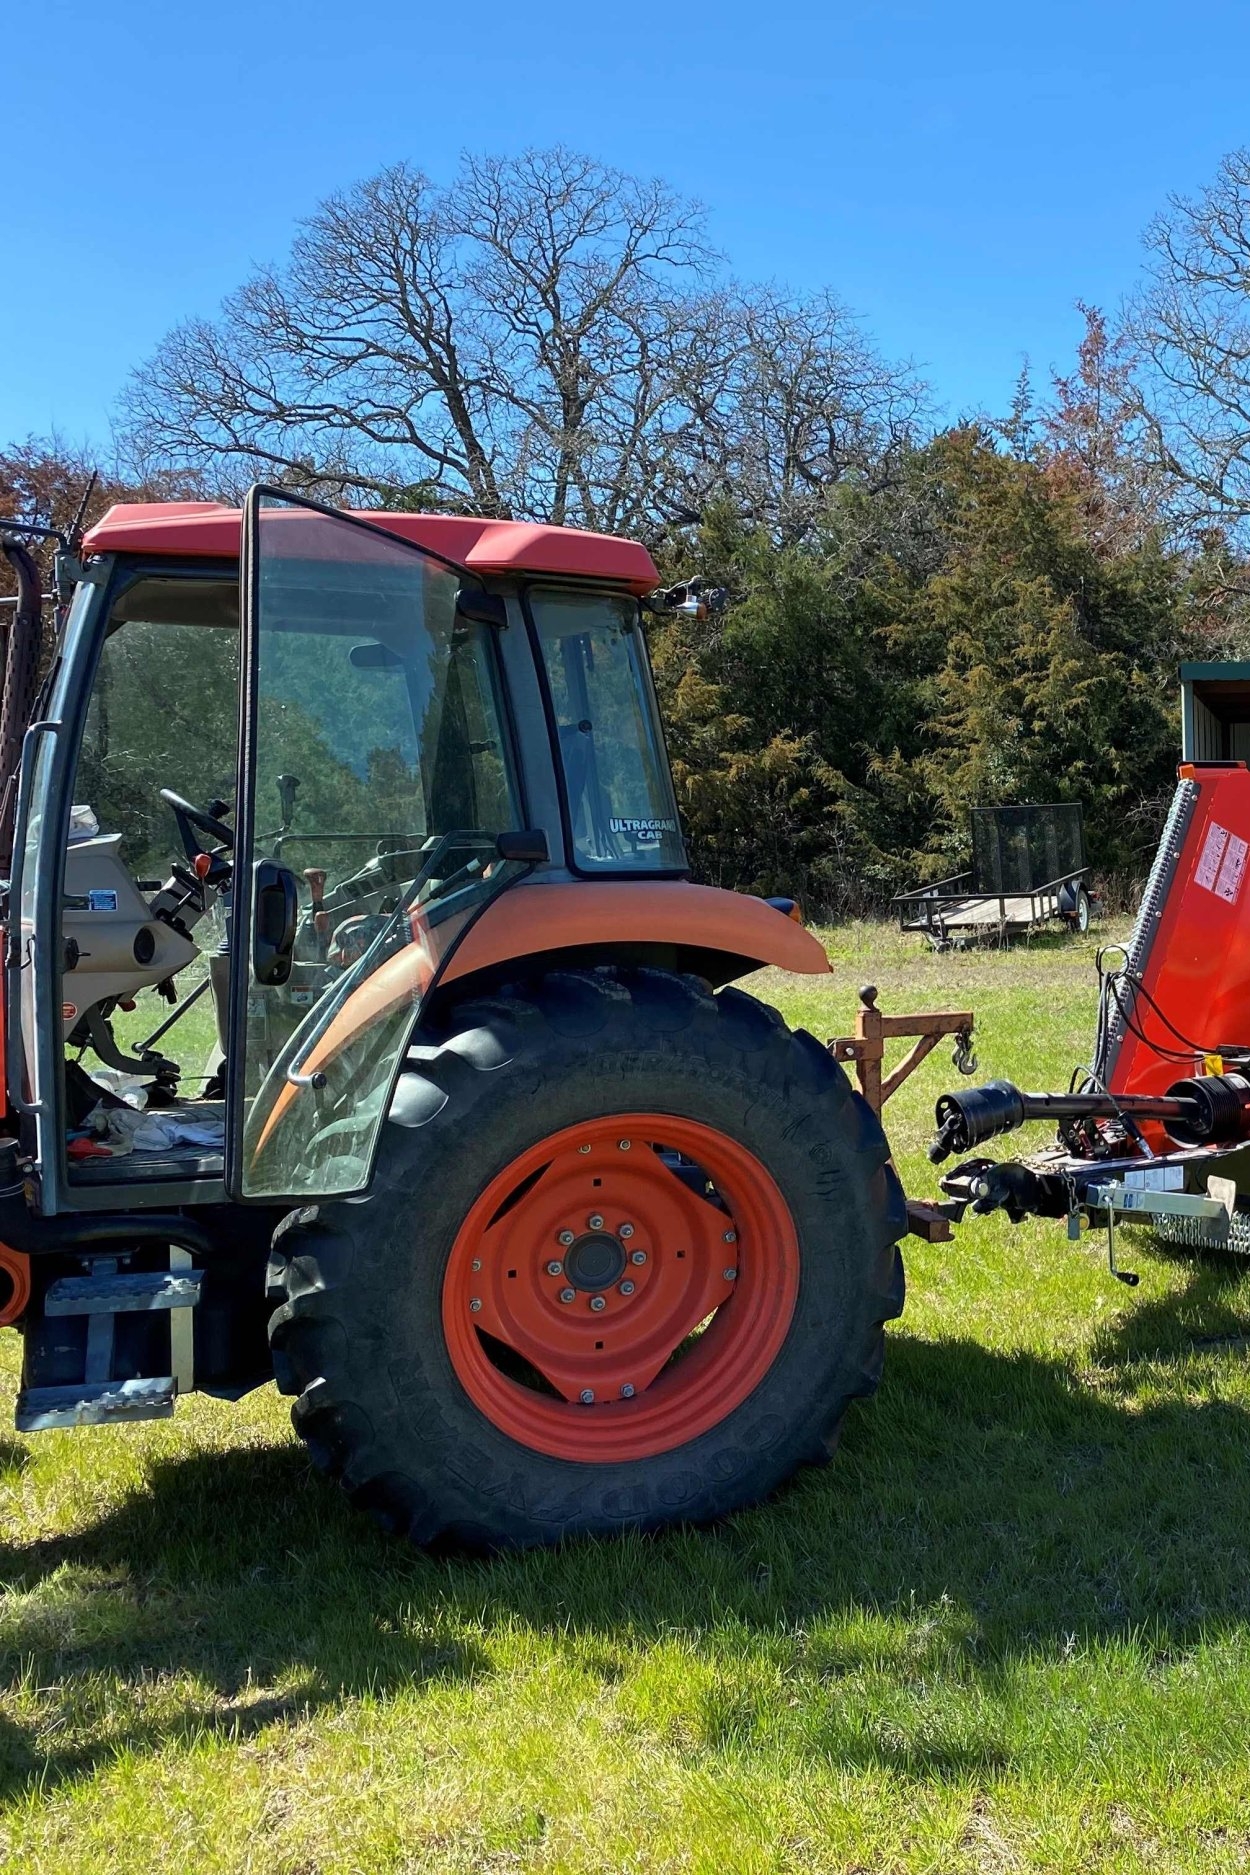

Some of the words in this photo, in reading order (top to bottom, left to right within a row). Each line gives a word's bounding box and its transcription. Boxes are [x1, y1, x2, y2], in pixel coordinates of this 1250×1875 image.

[609, 818, 677, 833] ULTRAGRAND
[637, 830, 664, 840] CAB
[387, 1353, 788, 1524] GOODYEAR
